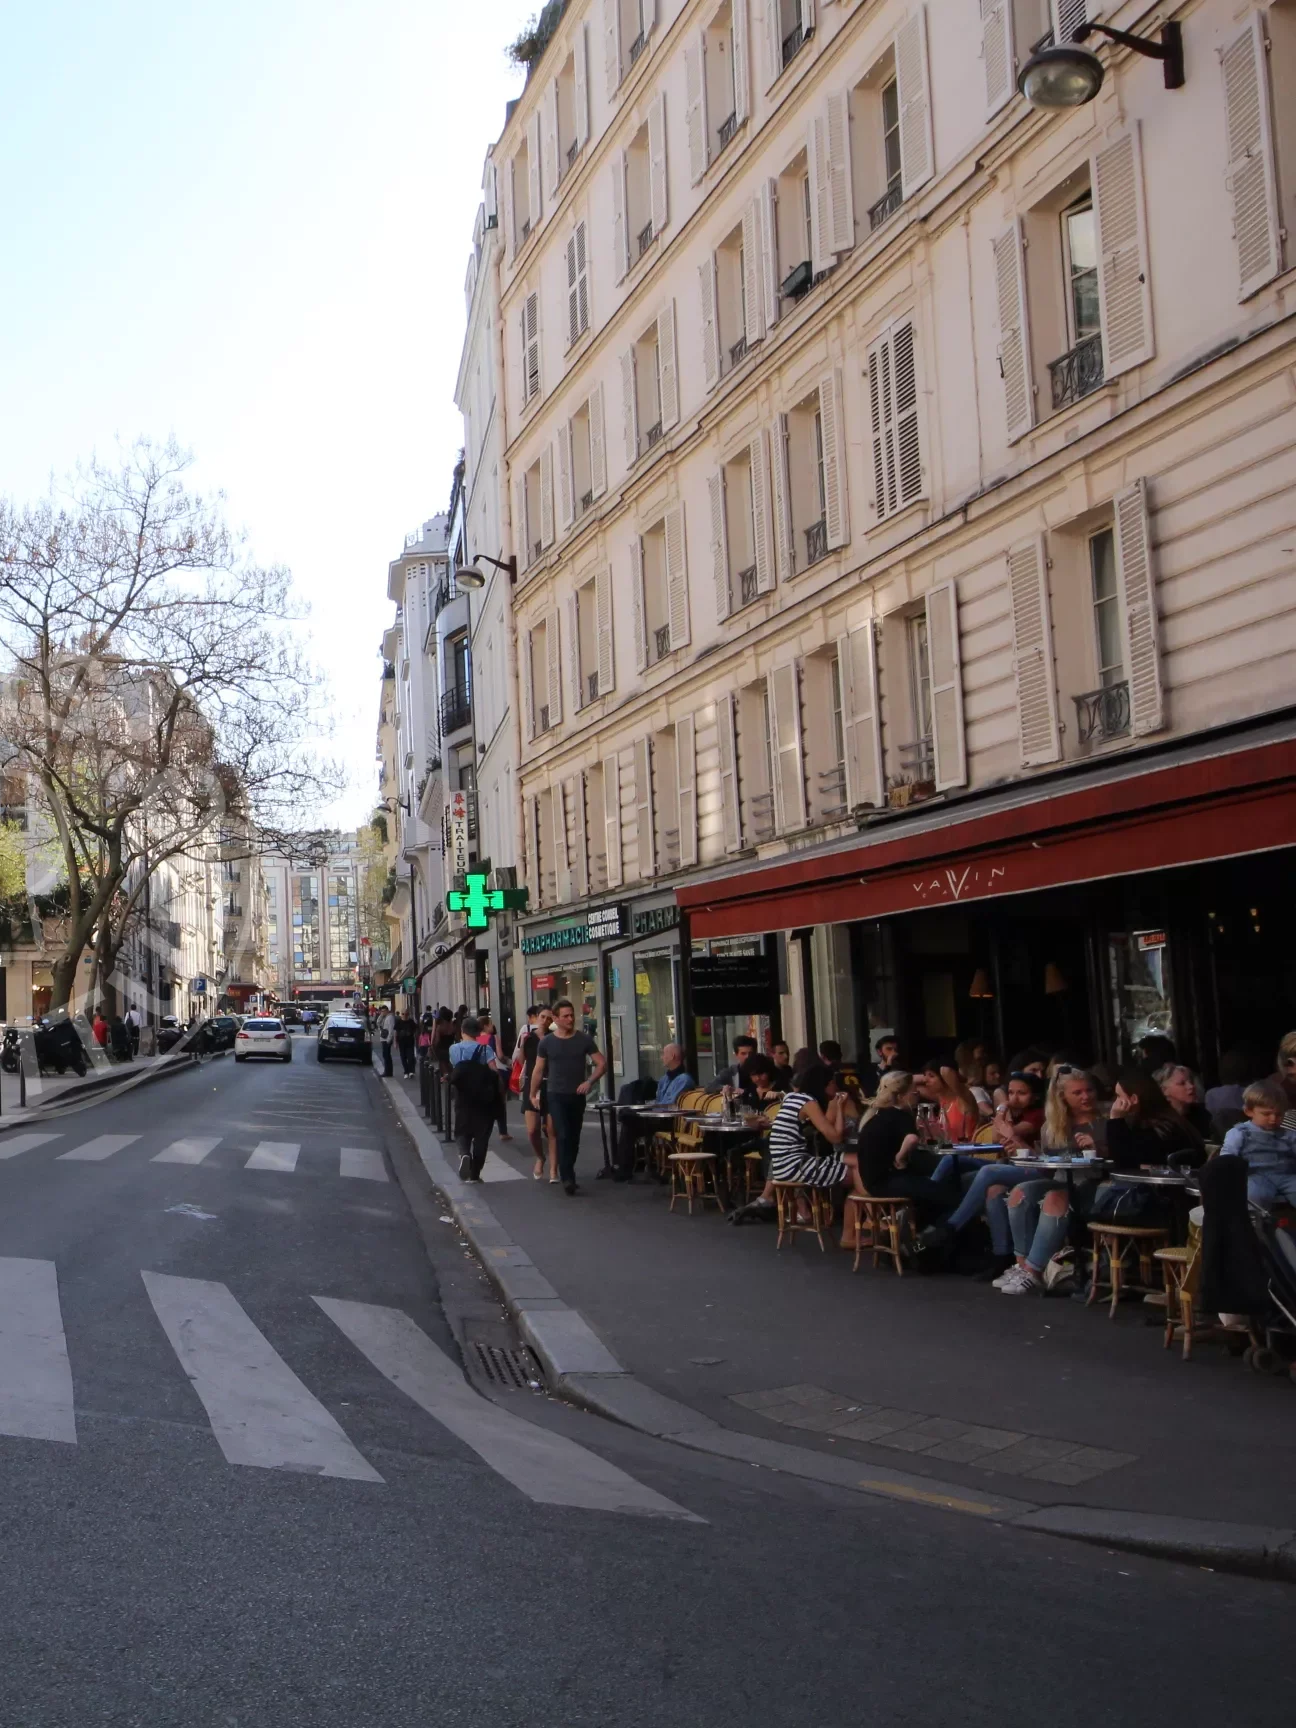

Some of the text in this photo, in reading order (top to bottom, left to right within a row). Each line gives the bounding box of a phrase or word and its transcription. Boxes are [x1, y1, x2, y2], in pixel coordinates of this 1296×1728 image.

[455, 821, 466, 874] TRAITEUR
[913, 866, 1005, 899] VAVIN
[521, 925, 589, 953] PARAPHARMACIE
